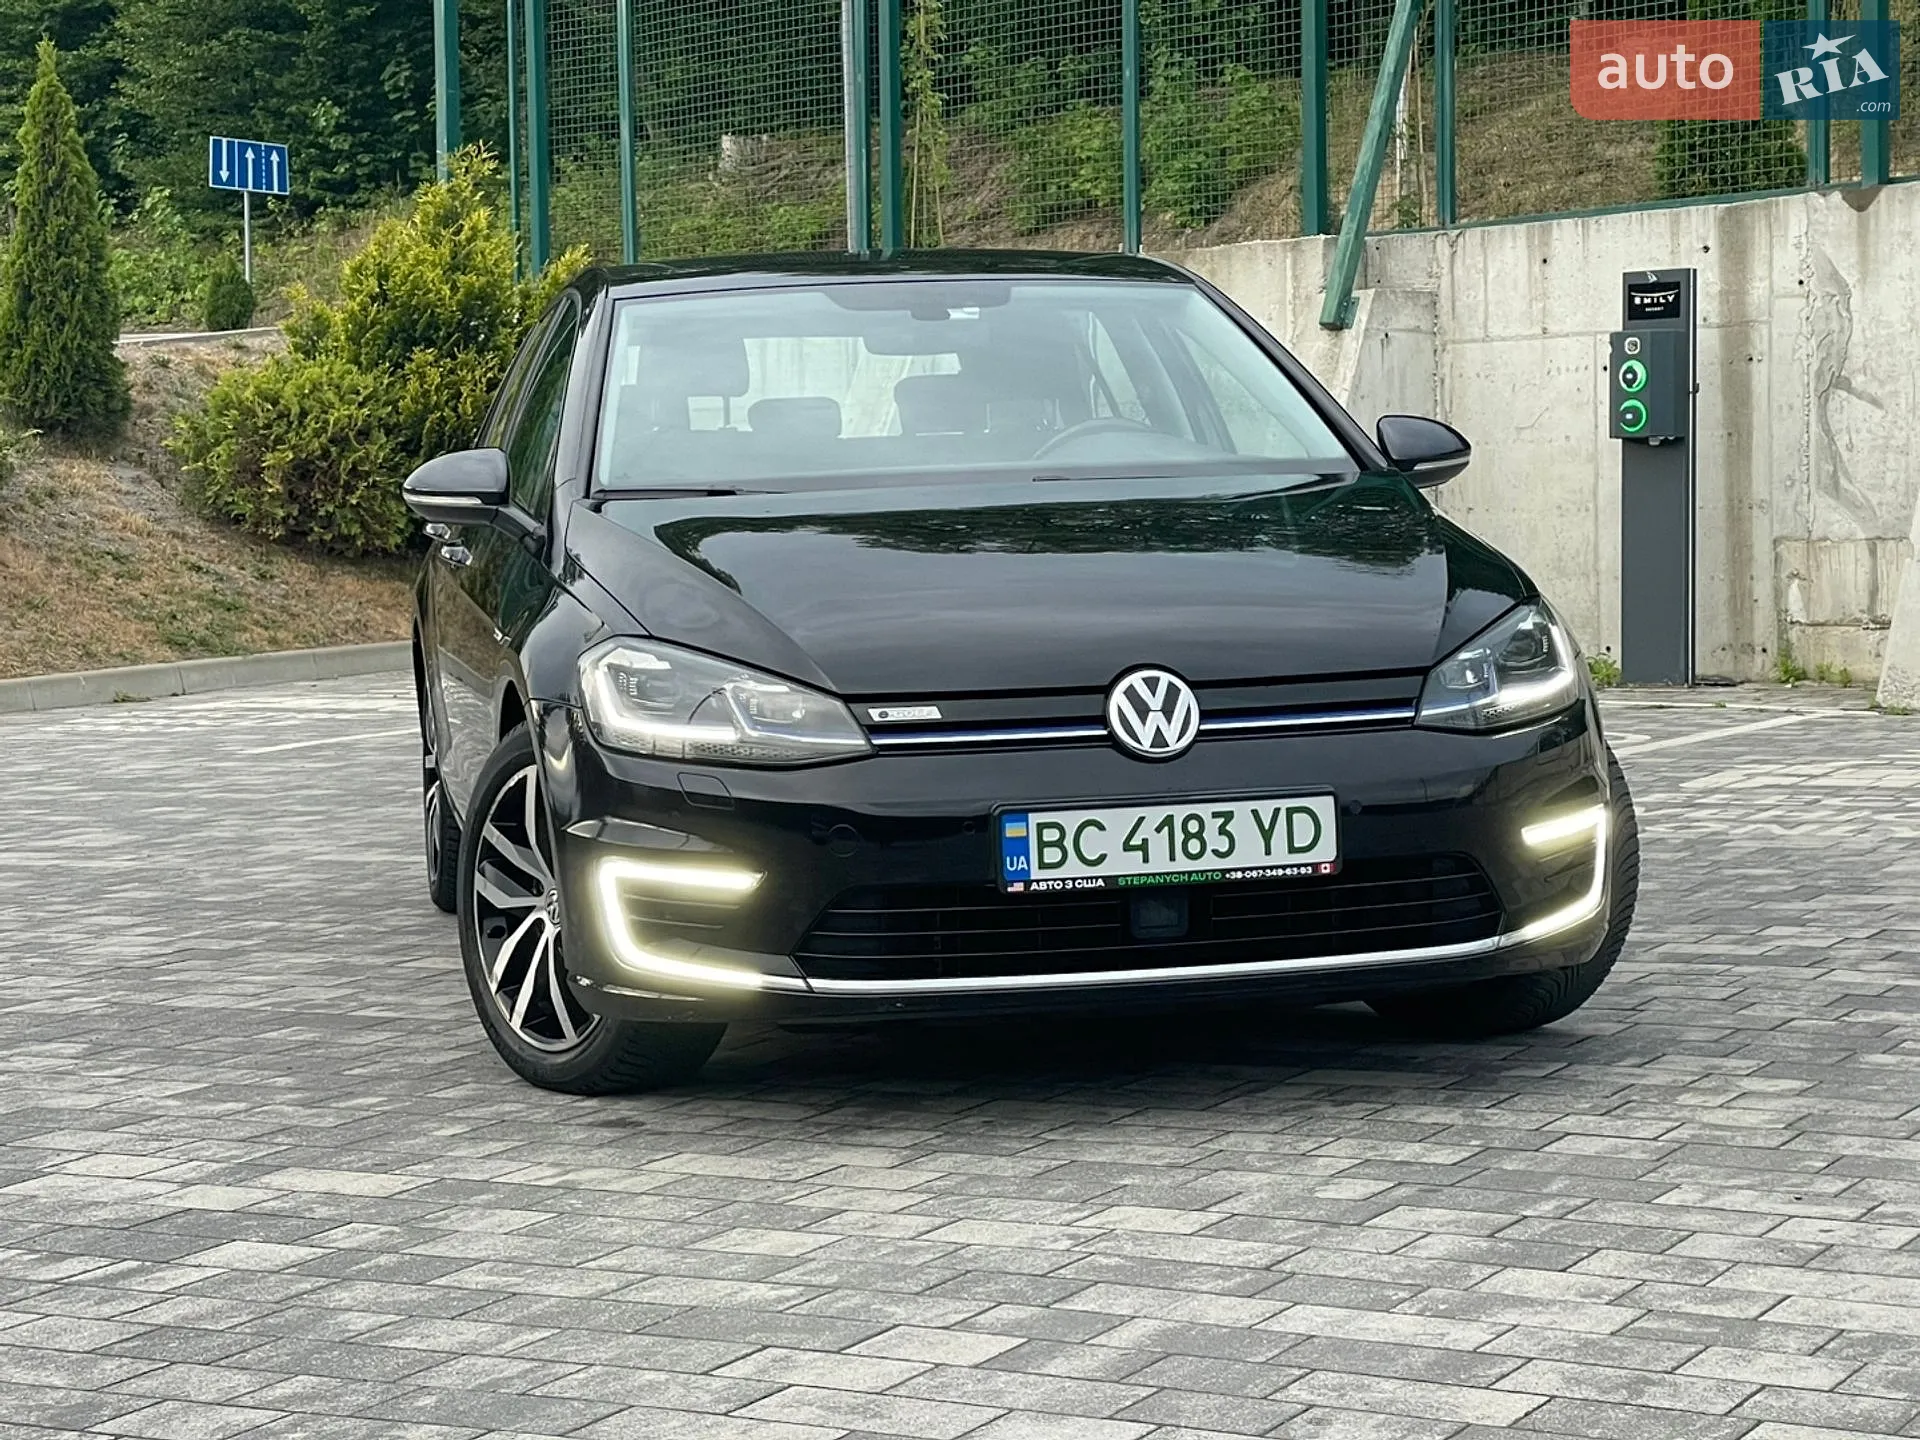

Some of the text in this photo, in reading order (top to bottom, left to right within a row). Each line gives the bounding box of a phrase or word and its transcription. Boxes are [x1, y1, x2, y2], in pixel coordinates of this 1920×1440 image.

[1036, 806, 1323, 870] BC 4183 YD
[1006, 856, 1029, 871] UA
[1030, 880, 1063, 891] АВТО
[1074, 878, 1105, 888] США
[1118, 871, 1222, 886] STEPANYCH AUTO
